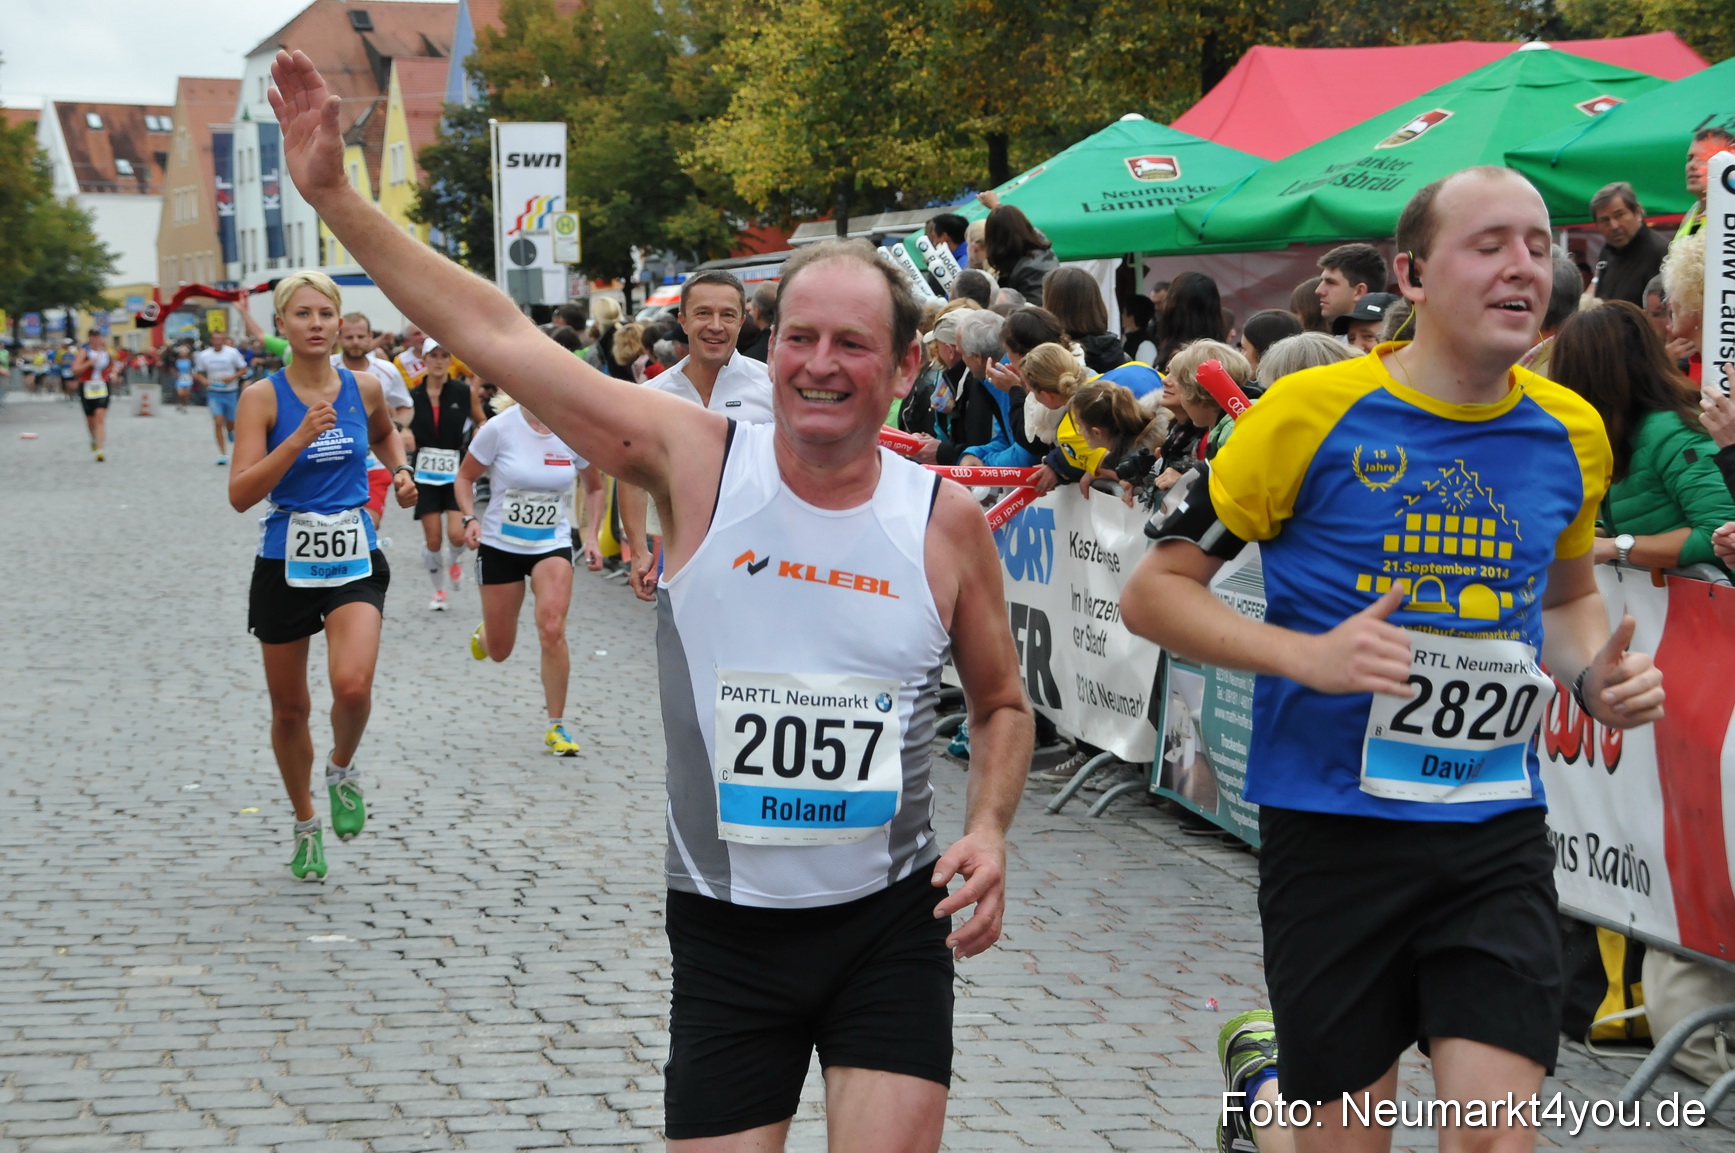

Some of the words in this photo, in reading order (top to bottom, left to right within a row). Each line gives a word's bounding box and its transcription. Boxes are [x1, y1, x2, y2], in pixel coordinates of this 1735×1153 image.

[506, 153, 562, 168] swn
[1102, 184, 1217, 200] Neumarkte
[1081, 195, 1195, 214] Lamms
[308, 437, 354, 448] AMSAUER
[1373, 450, 1387, 459] 15
[421, 456, 455, 473] 2133
[979, 468, 999, 477] BKK
[1000, 469, 1021, 478] Audi
[1365, 463, 1395, 473] Jahre
[509, 503, 557, 526] 3322
[1003, 497, 1025, 517] Audi
[988, 516, 1003, 530] BK
[296, 528, 358, 558] 2567
[310, 565, 348, 579] Sophia
[1383, 560, 1476, 576] 21.September
[1480, 565, 1510, 579] 2014
[778, 560, 899, 600] KLEBL
[1413, 650, 1450, 670] RTL
[721, 685, 781, 704] PARTL
[786, 690, 869, 710] Neumarkt
[1097, 683, 1145, 719] Neumark
[1389, 674, 1539, 741] 2820
[733, 713, 884, 781] 2057
[722, 769, 728, 781] C
[761, 795, 847, 822] Roland
[1586, 832, 1651, 897] Radio
